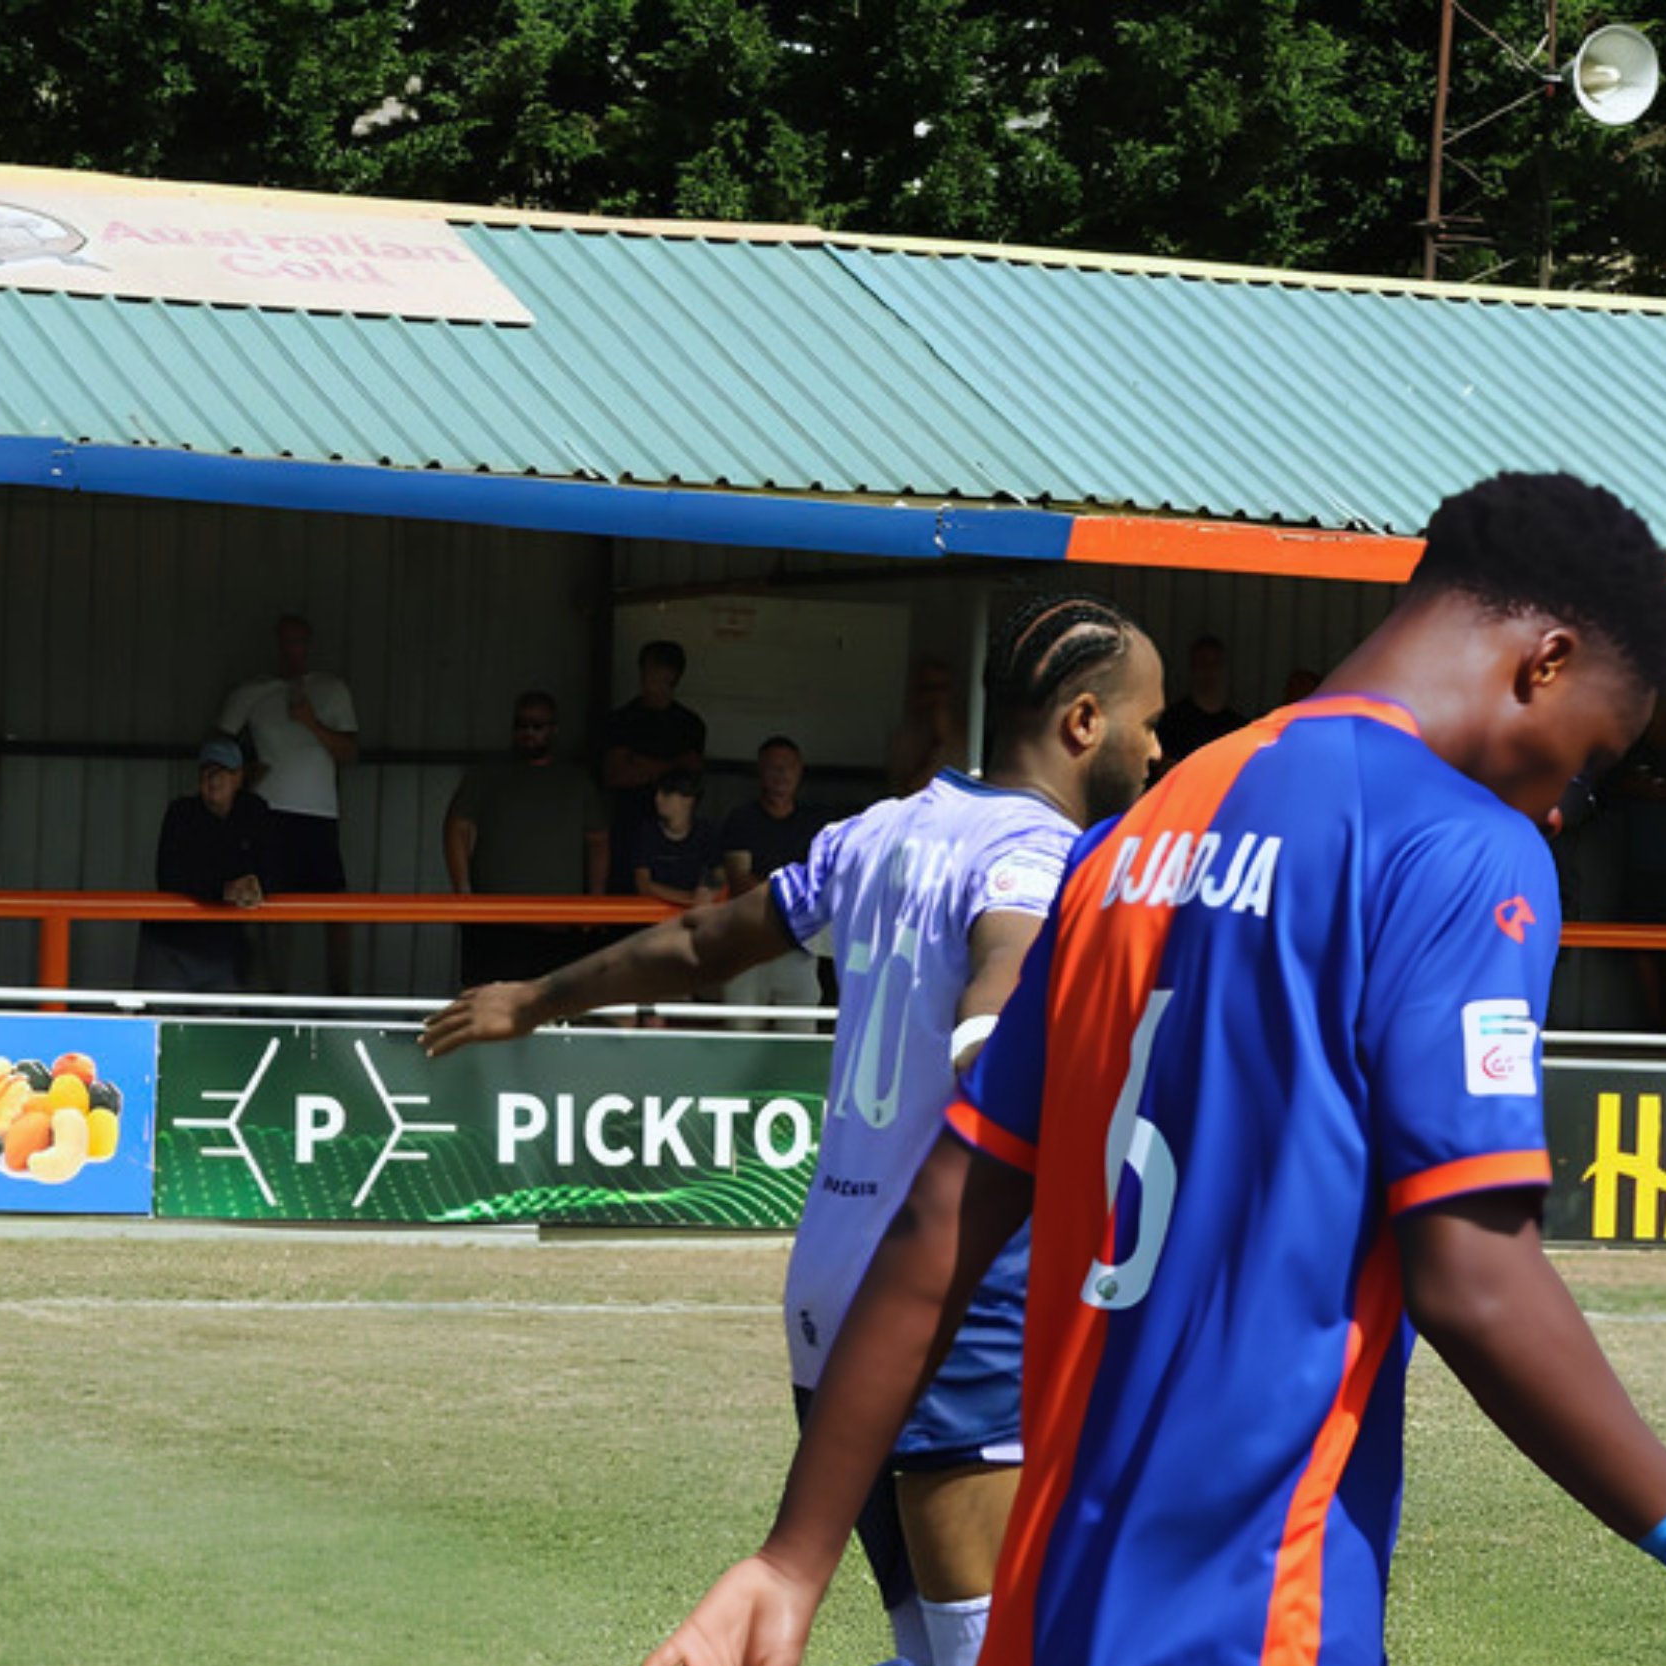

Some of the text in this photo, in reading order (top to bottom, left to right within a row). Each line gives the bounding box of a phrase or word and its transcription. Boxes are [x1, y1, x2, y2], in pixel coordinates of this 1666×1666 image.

[101, 219, 471, 264] Australian
[295, 1095, 346, 1163] P
[497, 1092, 827, 1171] PICKTO
